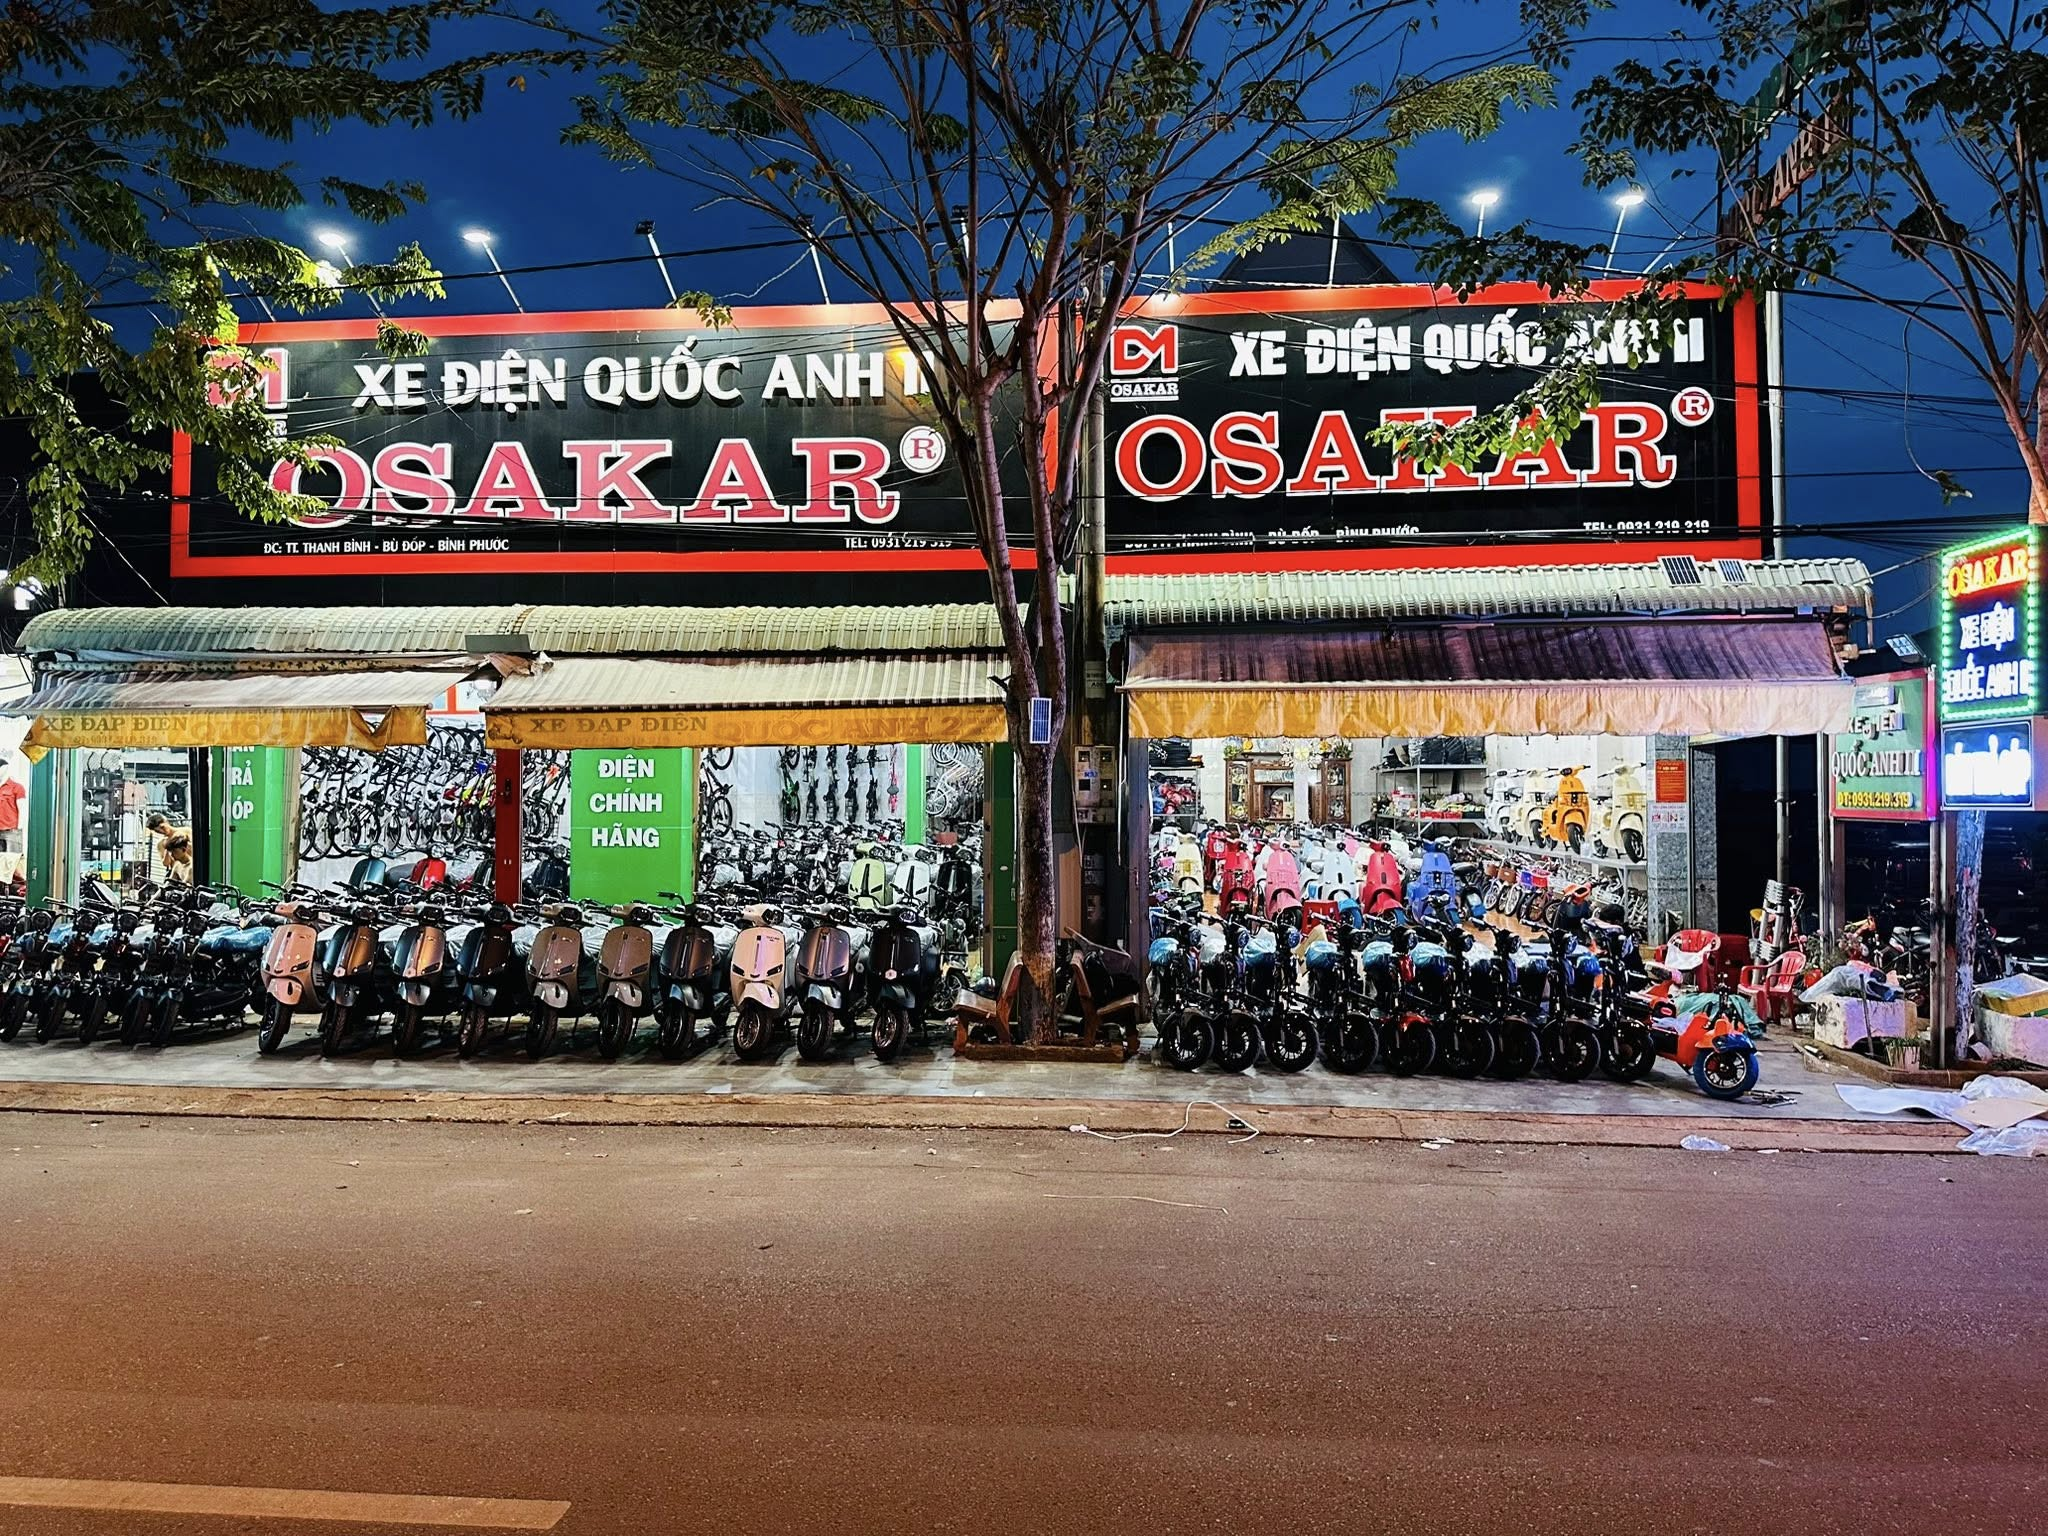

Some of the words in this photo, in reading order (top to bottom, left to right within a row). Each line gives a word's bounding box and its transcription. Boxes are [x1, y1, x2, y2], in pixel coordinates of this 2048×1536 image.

[1229, 330, 1287, 377] XE
[1305, 317, 1411, 380] ĐIỆN
[1424, 308, 1547, 375] QUỐC
[352, 363, 424, 408] XE
[441, 349, 564, 415] ĐIỆN
[583, 335, 740, 406] QUỐC
[762, 352, 883, 398] ANH
[1111, 382, 1179, 397] OSAKAR
[269, 437, 900, 528] OSAKAR
[263, 542, 282, 554] ĐC:
[303, 541, 340, 553] THANH
[344, 538, 371, 552] BÌNH
[382, 538, 399, 552] BÙ
[402, 536, 426, 552] ĐỐP
[438, 536, 465, 551] BÌNH
[469, 537, 510, 552] PHƯỚC
[844, 537, 867, 549] TEL:
[871, 537, 900, 549] 0931
[1948, 548, 2028, 597] OSAKAR
[1960, 613, 1980, 650] XE
[42, 716, 75, 732] XE
[81, 716, 125, 734] ĐẠP
[529, 717, 567, 732] XE
[576, 717, 631, 736] ĐẠP
[641, 712, 707, 735] ĐIỆN
[598, 754, 655, 783] ĐIỆN
[1869, 750, 1903, 776] ANH
[589, 788, 662, 813] CHÍNH
[591, 822, 660, 848] HÃNG
